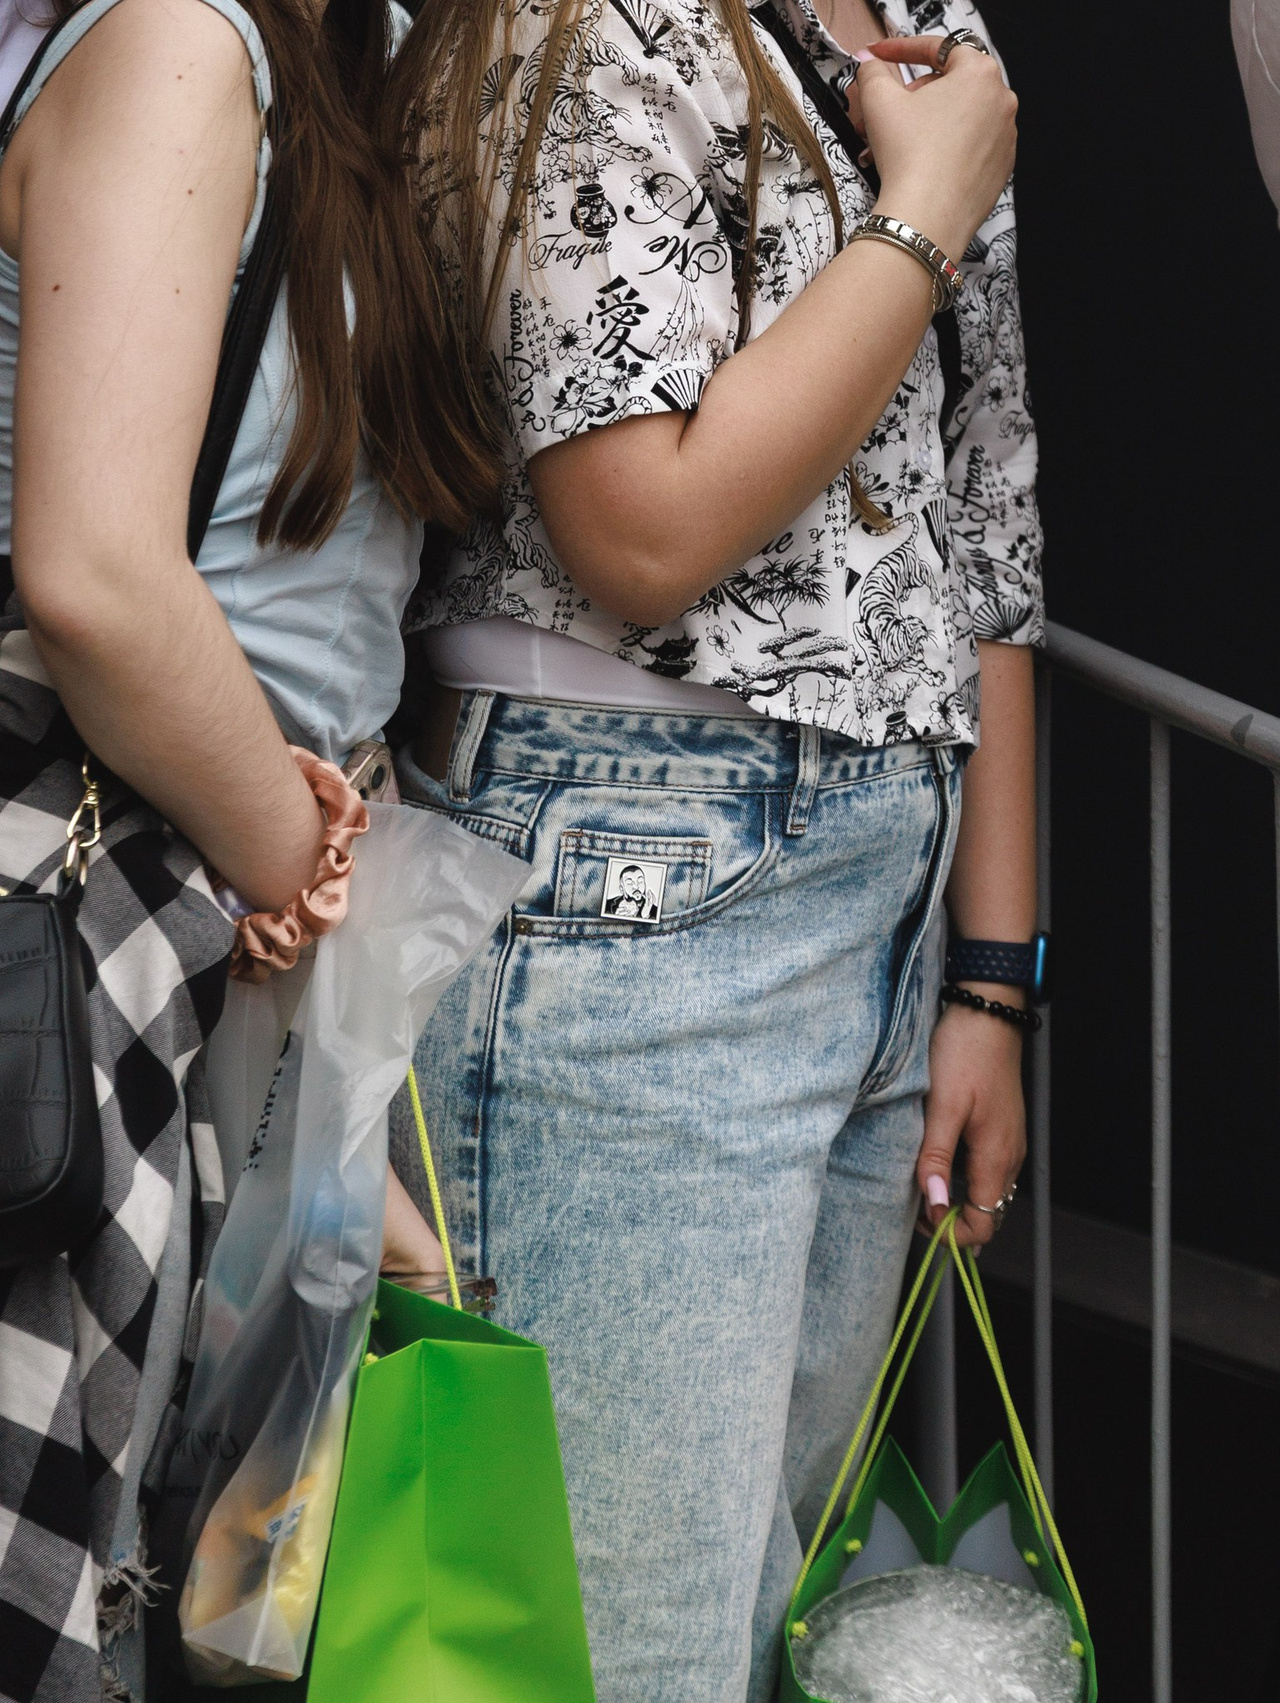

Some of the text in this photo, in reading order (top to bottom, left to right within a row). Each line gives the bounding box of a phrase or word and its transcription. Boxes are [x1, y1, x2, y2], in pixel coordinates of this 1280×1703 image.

[528, 230, 613, 271] Fragile
[504, 289, 535, 392] Forever
[586, 274, 656, 360] 愛
